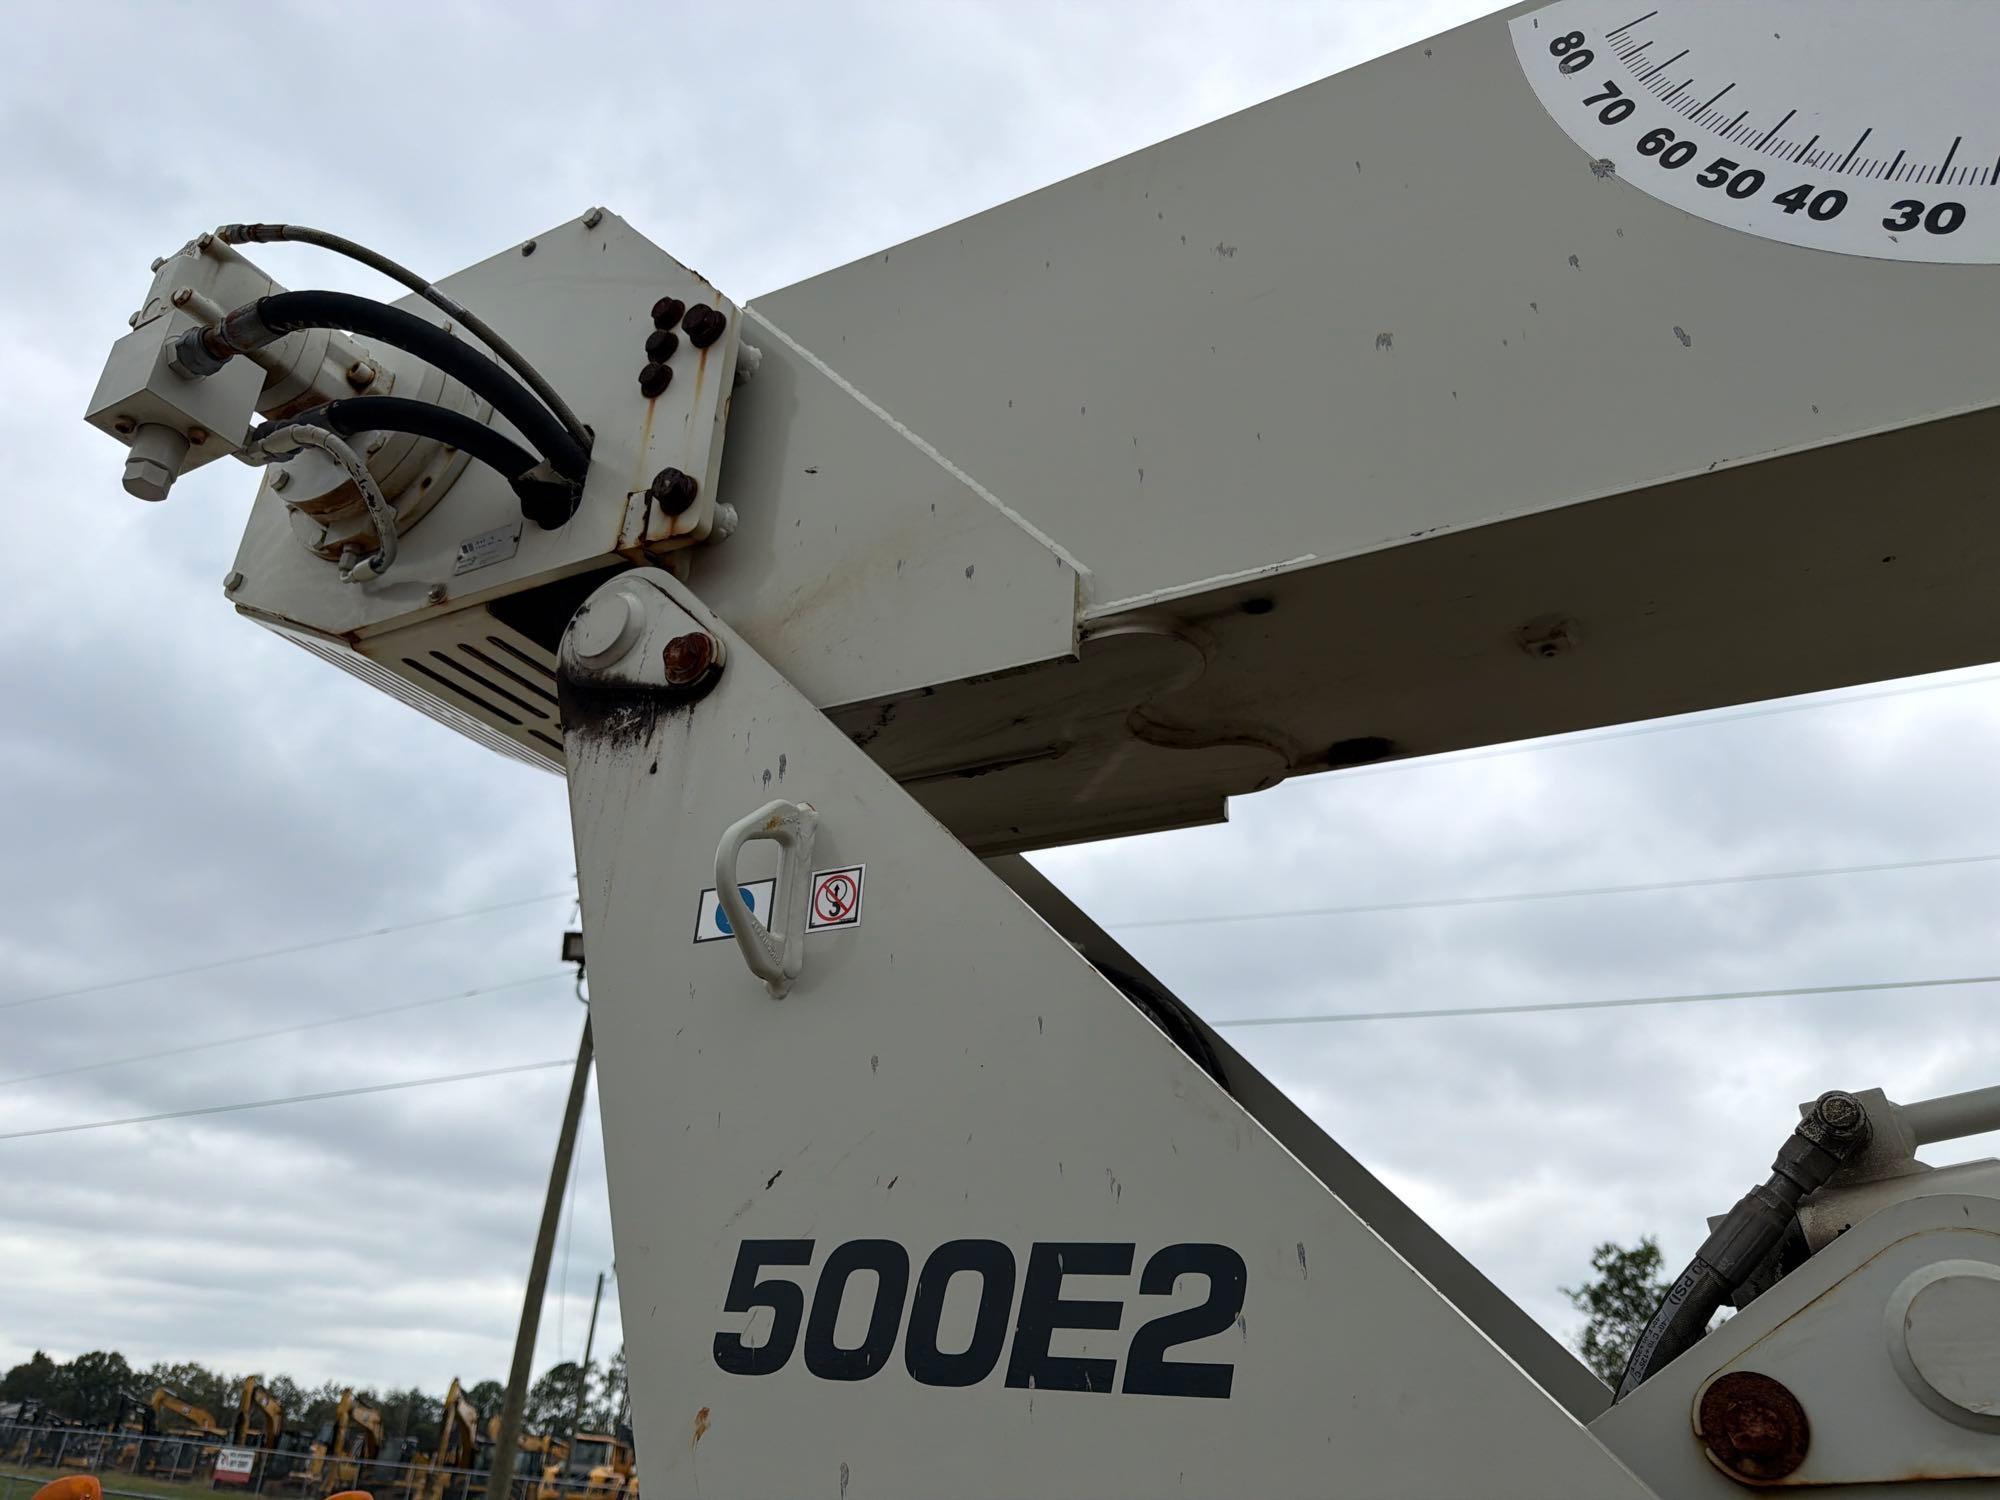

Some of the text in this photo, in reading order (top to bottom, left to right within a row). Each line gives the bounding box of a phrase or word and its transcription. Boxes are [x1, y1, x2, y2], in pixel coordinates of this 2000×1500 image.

[1549, 30, 1594, 75] 80
[1582, 80, 1636, 125] 70
[1636, 127, 1697, 169] 60
[1696, 157, 1765, 199] 50
[1772, 184, 1848, 221] 40
[1882, 199, 1966, 235] 30
[713, 1239, 1248, 1399] 500E2
